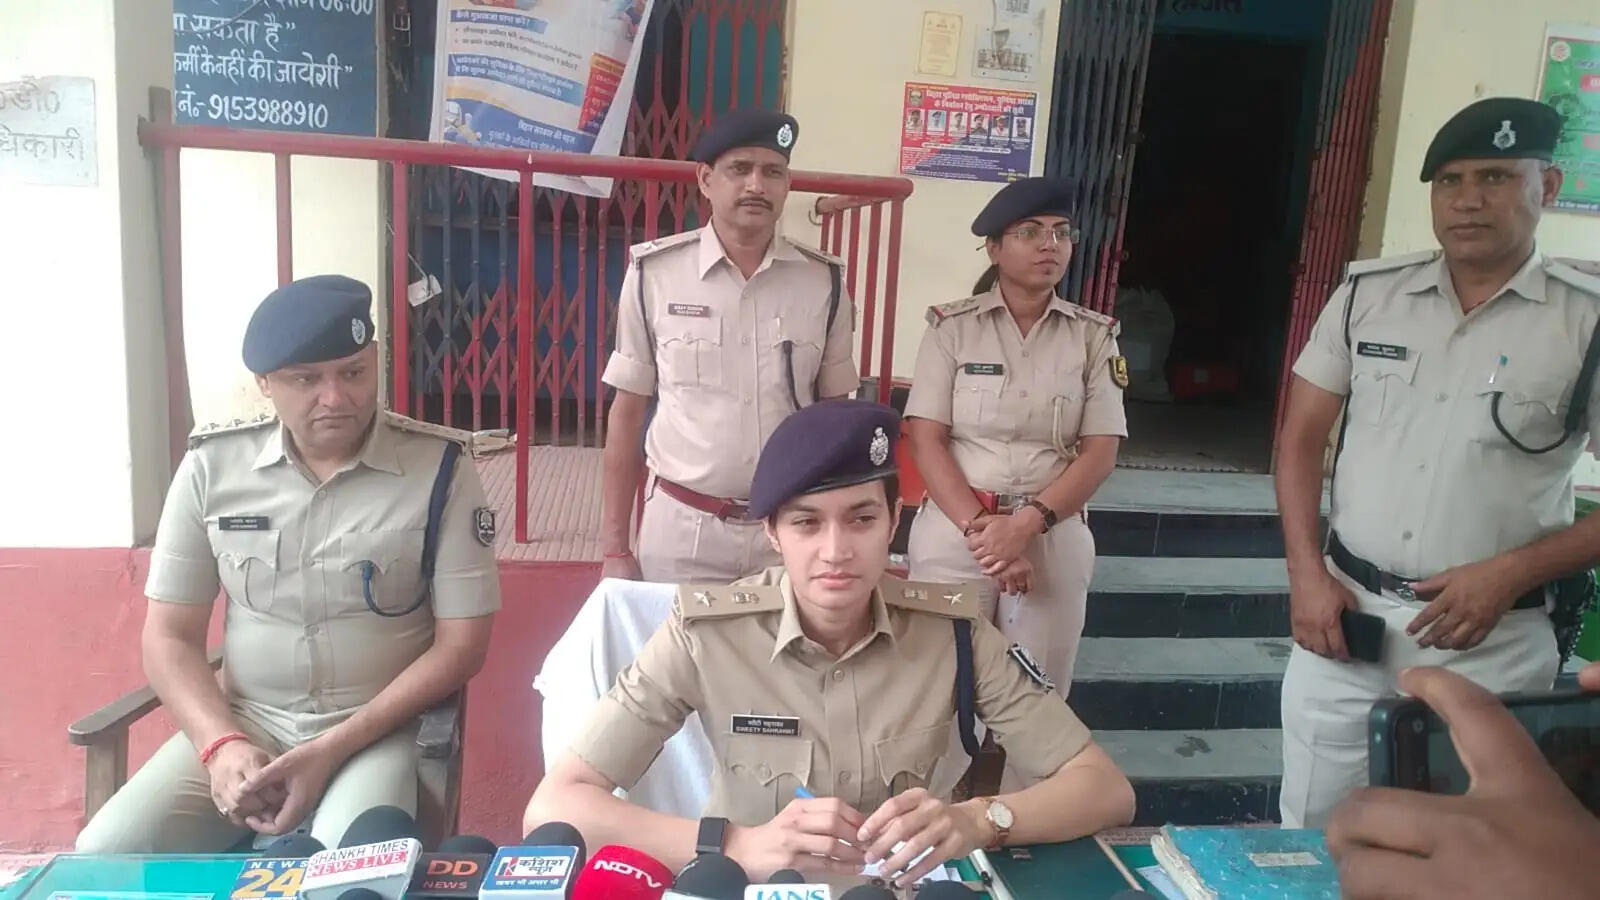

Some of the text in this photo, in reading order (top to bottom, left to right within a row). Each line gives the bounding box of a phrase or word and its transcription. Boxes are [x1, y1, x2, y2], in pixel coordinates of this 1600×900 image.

[190, 14, 259, 46] सकता
[248, 50, 274, 83] की
[369, 839, 409, 856] TIMES
[250, 860, 308, 869] NEWS
[427, 860, 478, 876] DD
[519, 857, 565, 867] कशिश
[594, 859, 663, 889] NDTV
[231, 867, 306, 899] 24
[423, 880, 468, 890] NEWS
